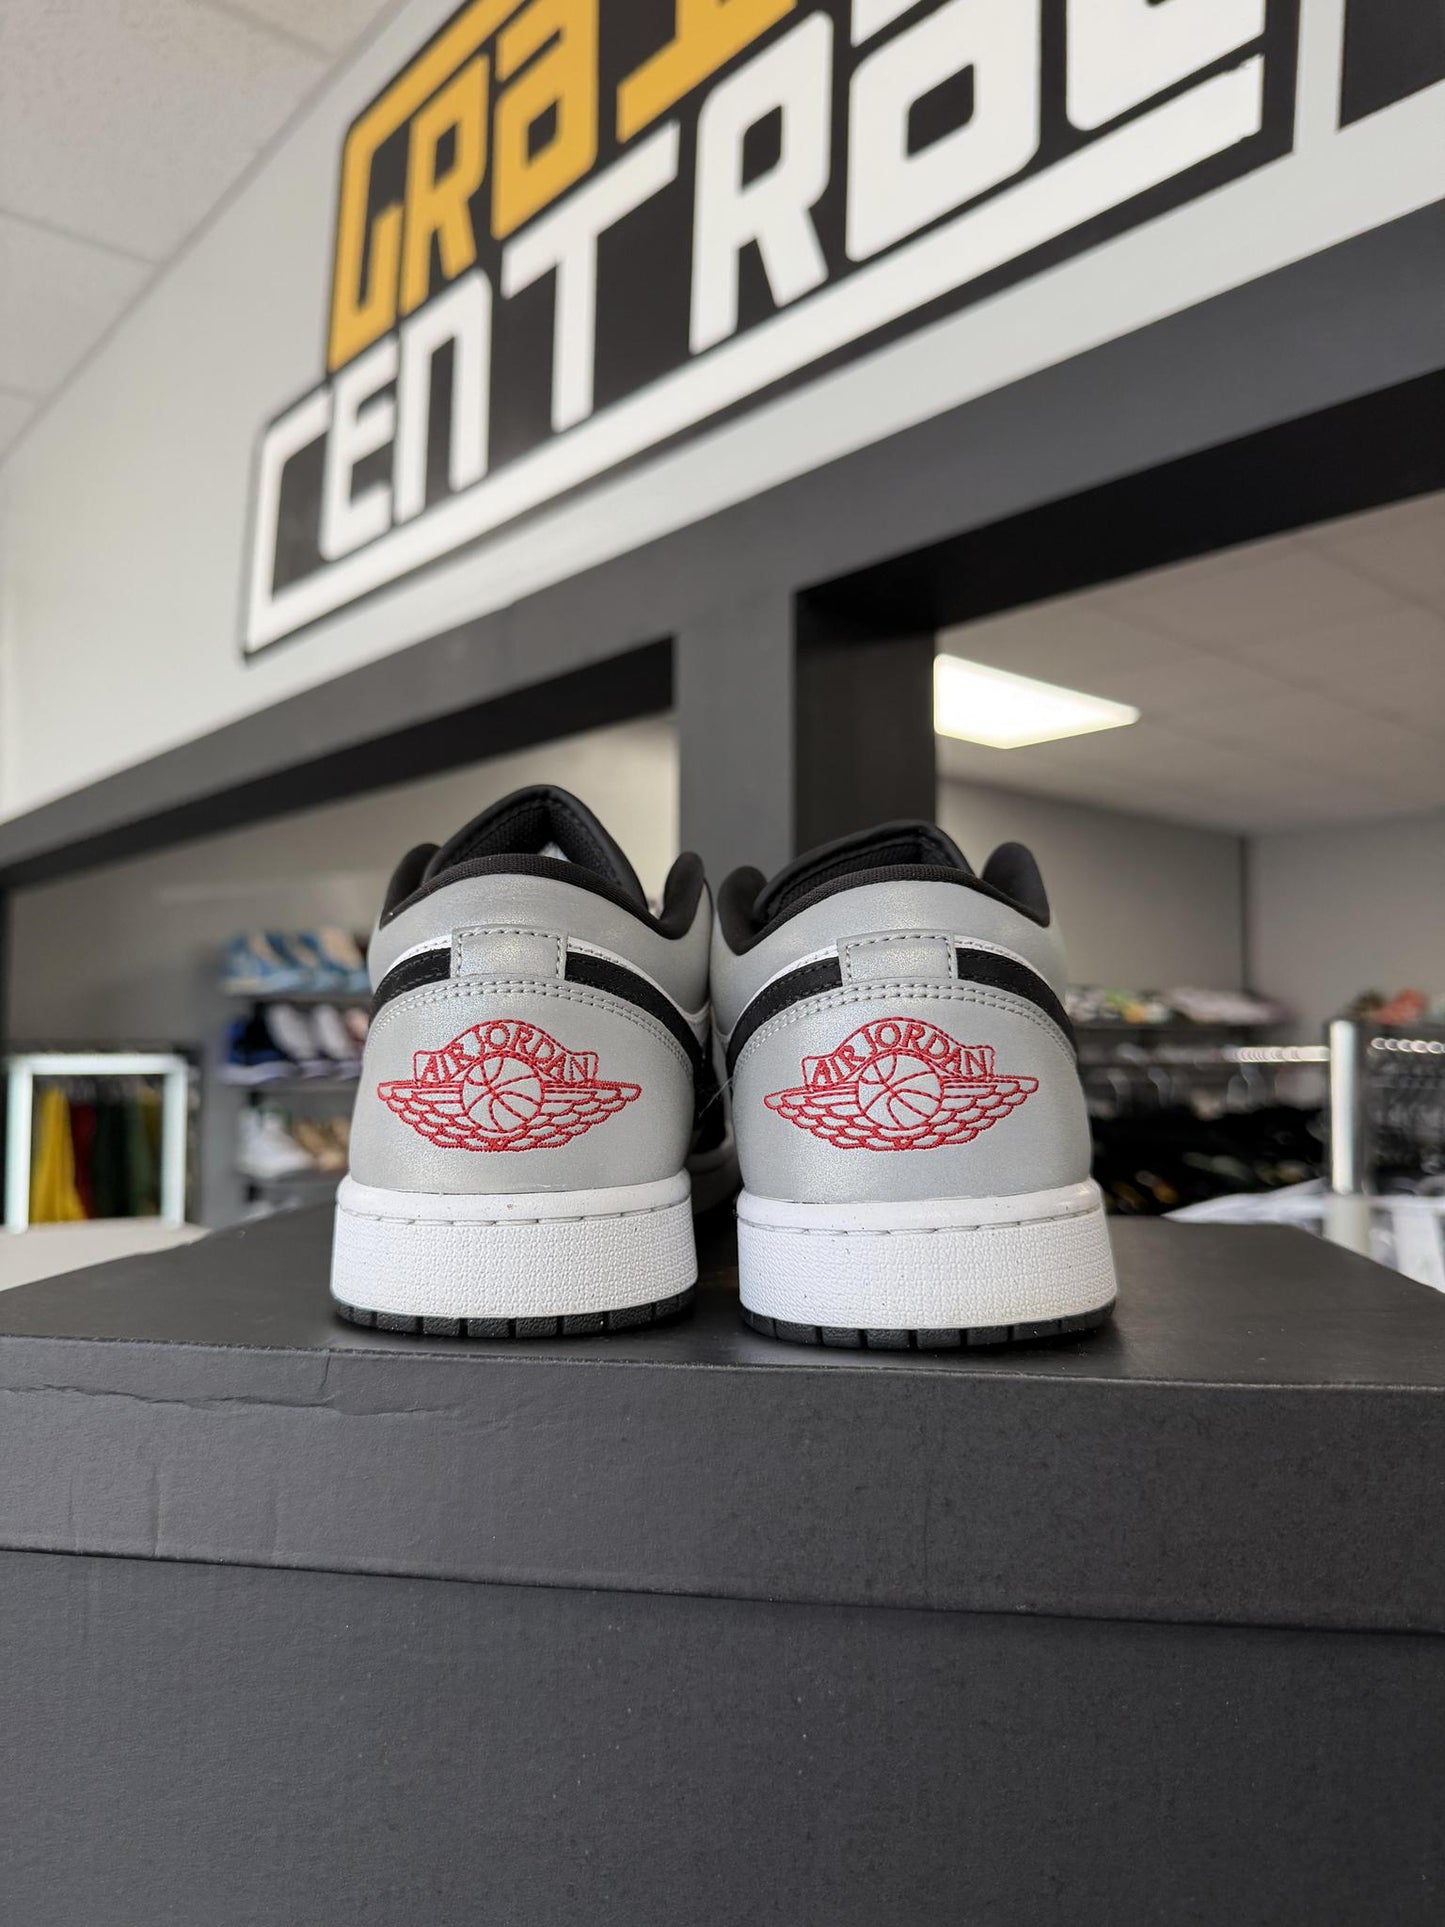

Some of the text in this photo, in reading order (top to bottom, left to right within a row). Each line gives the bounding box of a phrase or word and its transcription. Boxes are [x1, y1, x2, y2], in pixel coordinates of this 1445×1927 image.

[420, 1023, 589, 1083] AIR JORDAN
[811, 1022, 988, 1085] AIR JORDAN
